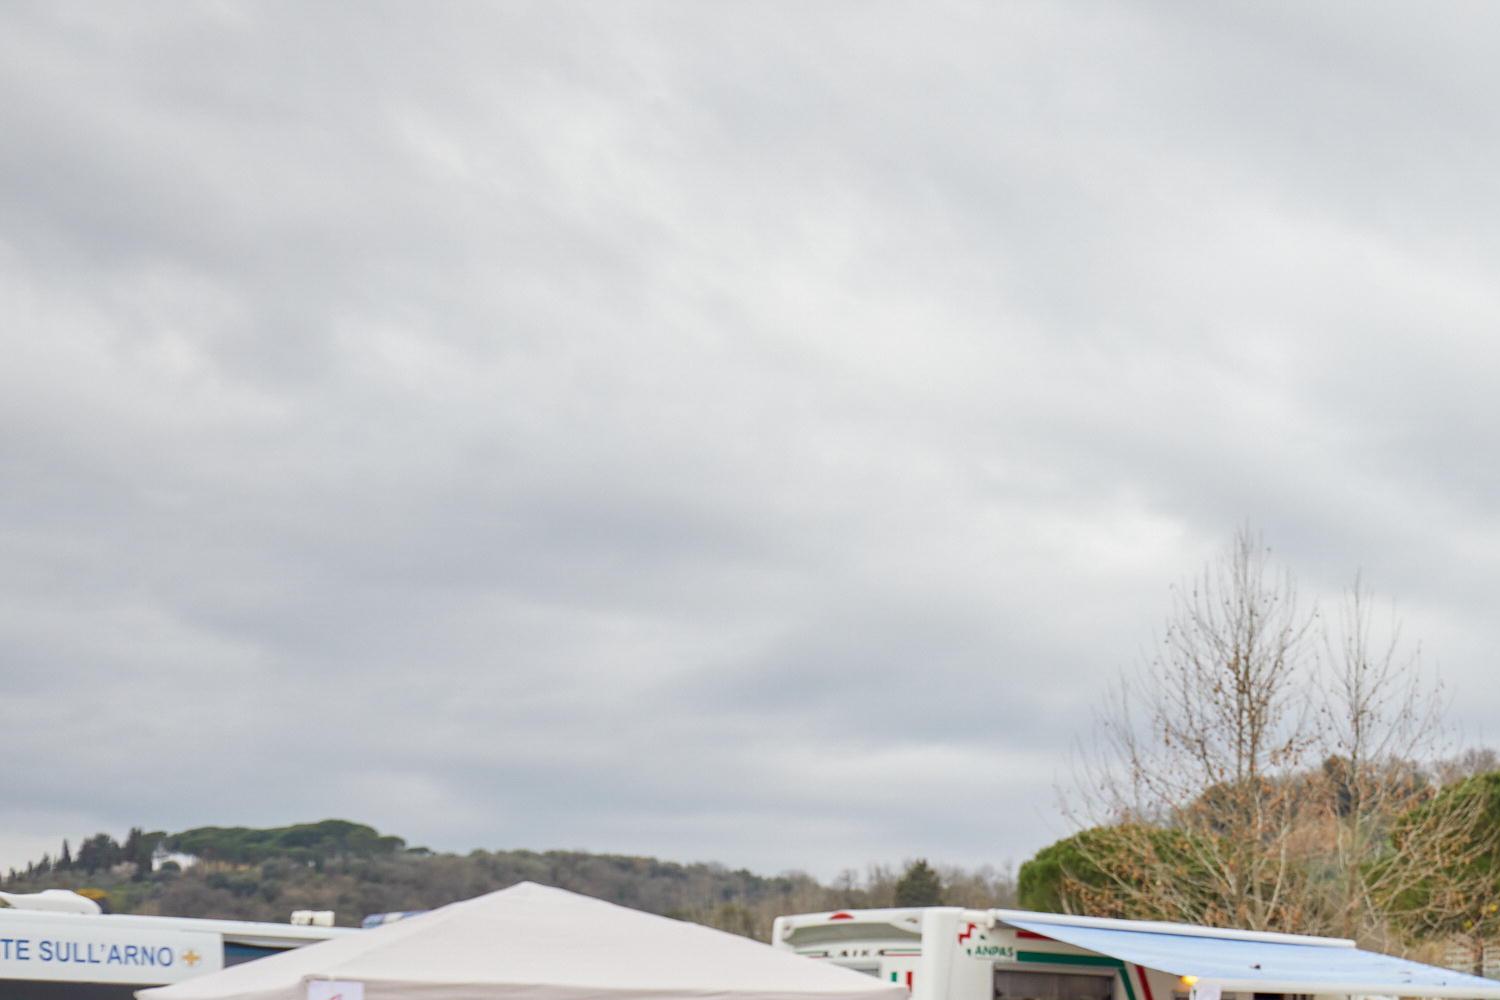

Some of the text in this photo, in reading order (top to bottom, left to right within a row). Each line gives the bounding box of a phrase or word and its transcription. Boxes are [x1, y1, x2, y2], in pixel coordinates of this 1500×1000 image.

[1, 939, 174, 967] TE SULL'ARNO
[975, 946, 1014, 957] ANPAS
